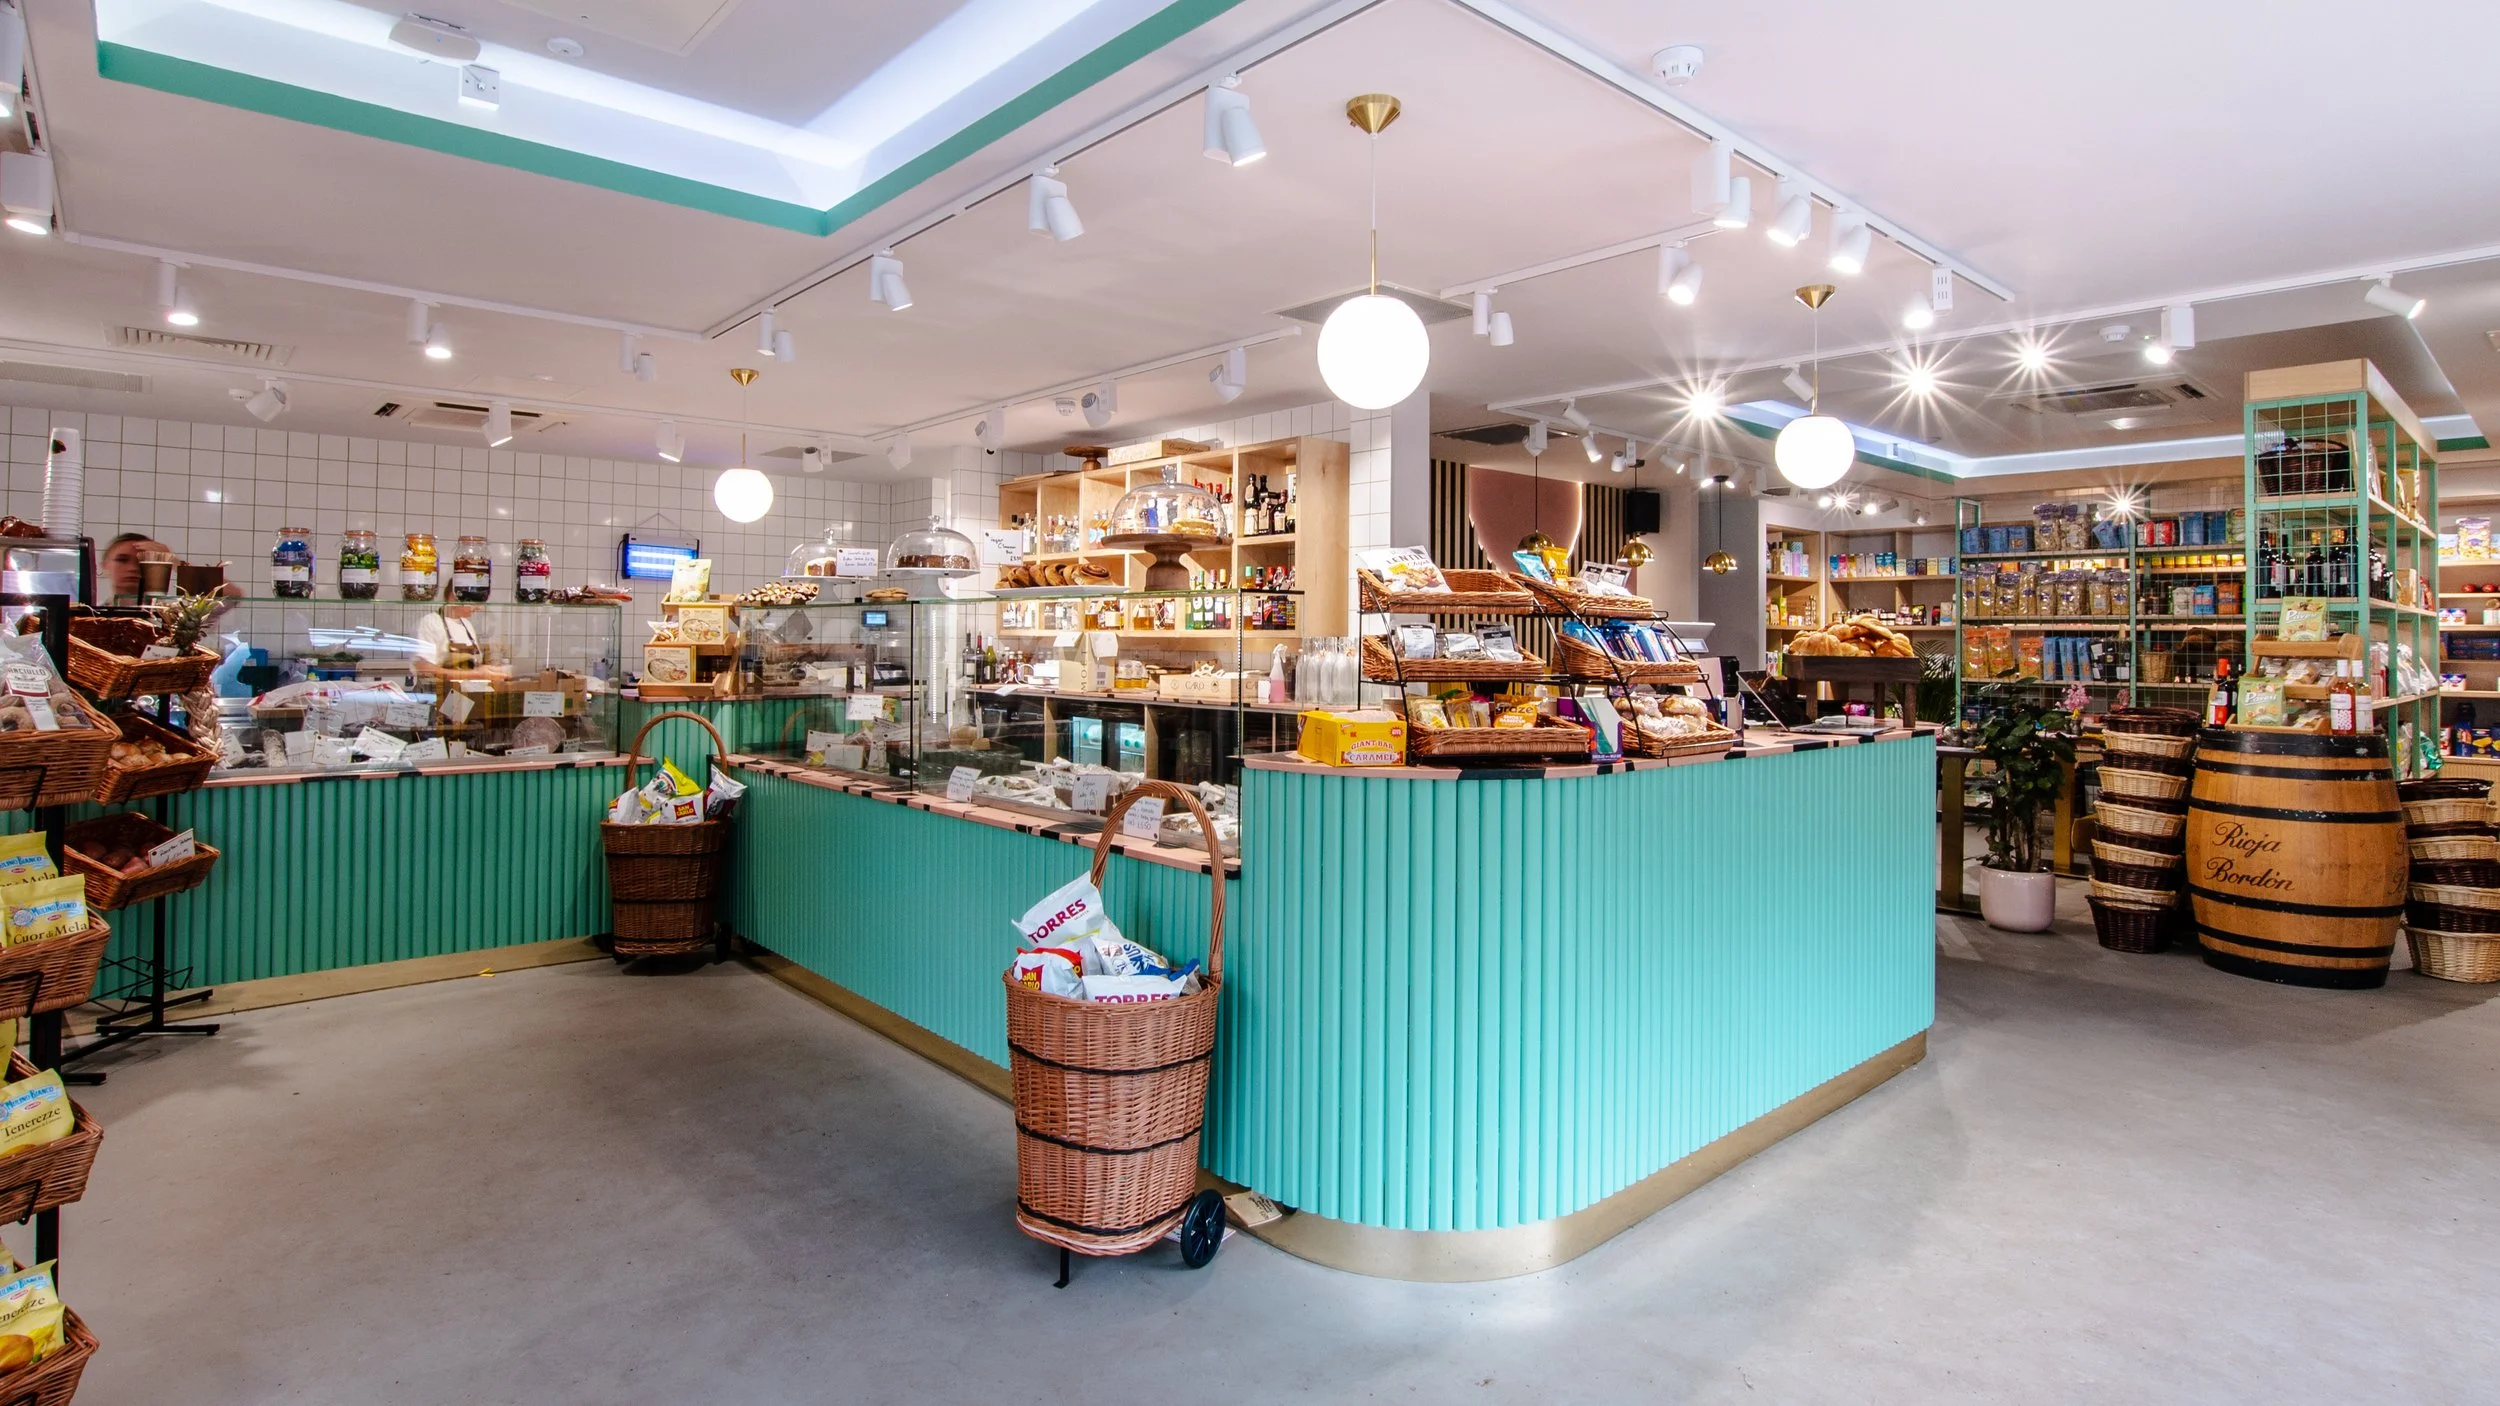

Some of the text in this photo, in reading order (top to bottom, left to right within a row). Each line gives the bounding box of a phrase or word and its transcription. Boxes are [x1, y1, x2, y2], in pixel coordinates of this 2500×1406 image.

[1495, 705, 1534, 715] graze
[1349, 753, 1395, 761] CARAMEL
[1351, 740, 1376, 750] GIANT
[2212, 821, 2282, 858] Rioja
[13, 931, 45, 945] Cuor
[54, 921, 88, 937] Mela
[1028, 898, 1087, 944] TORRES
[1, 1107, 61, 1137] Tenerezze
